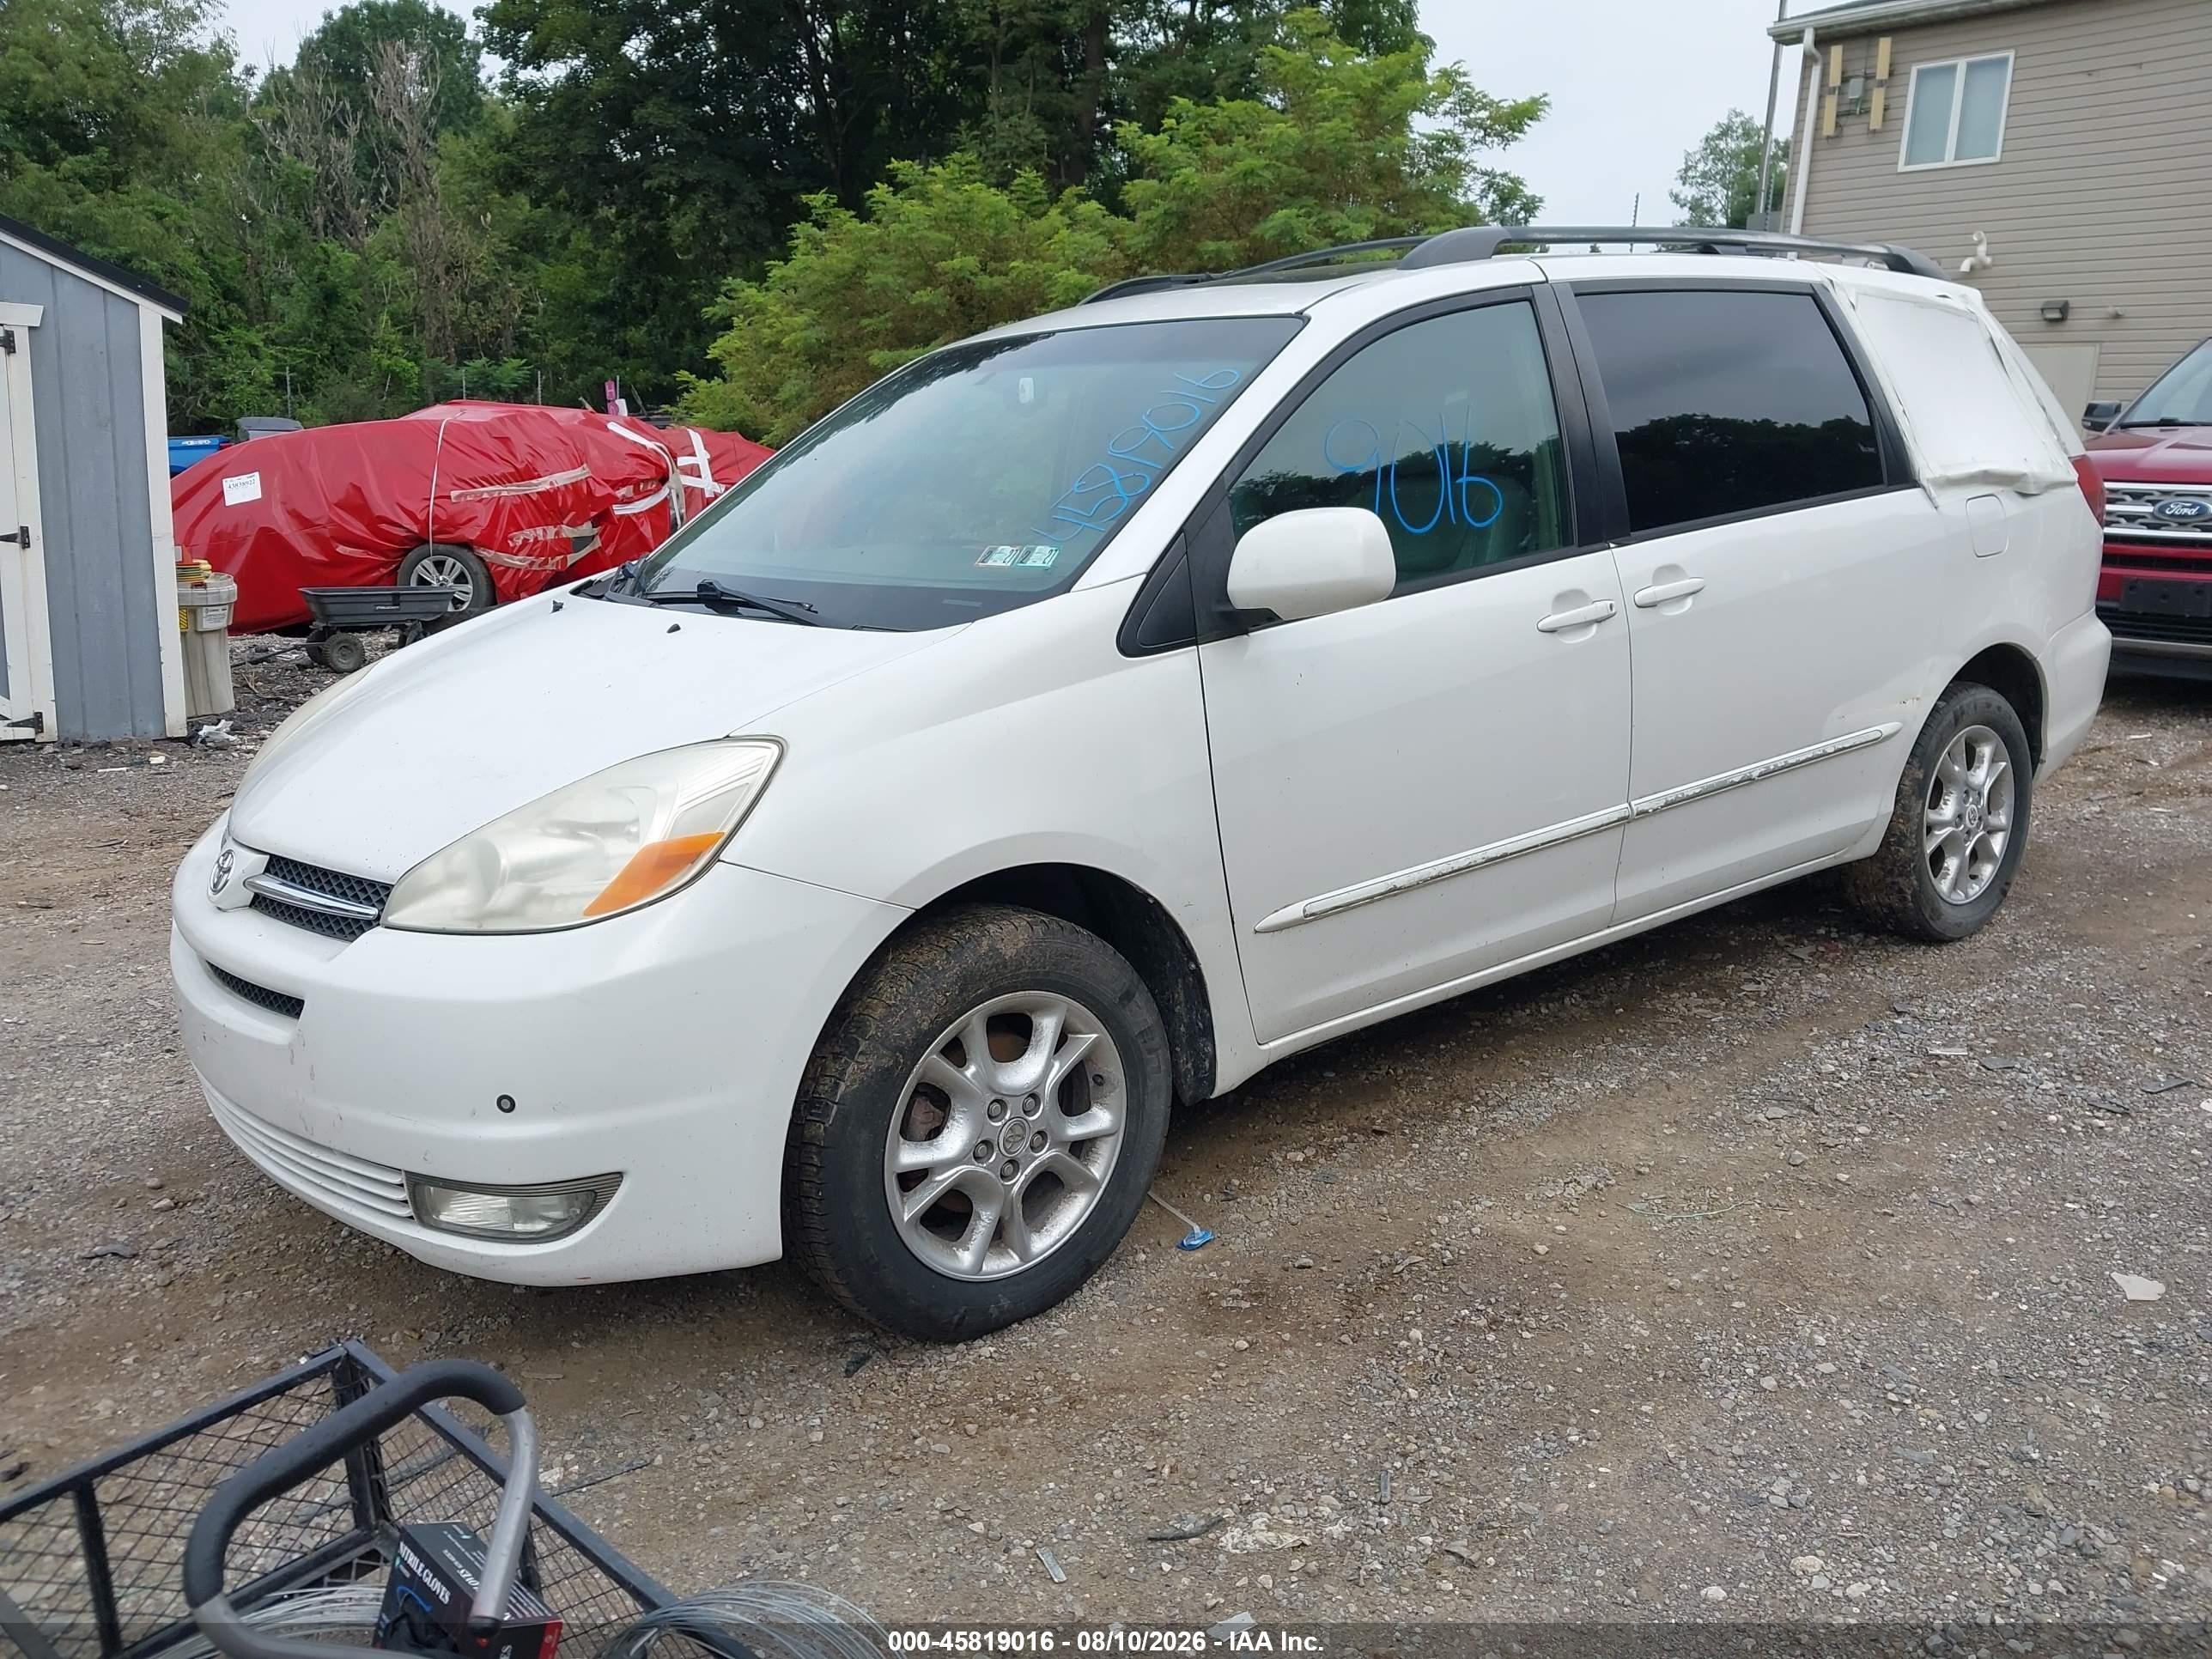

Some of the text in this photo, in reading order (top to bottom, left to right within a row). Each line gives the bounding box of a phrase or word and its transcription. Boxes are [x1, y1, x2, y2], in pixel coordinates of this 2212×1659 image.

[1030, 369, 1240, 542] 45819016
[1324, 404, 1502, 533] 9016
[2166, 501, 2200, 516] Ford
[398, 1541, 424, 1577] NITRILE
[422, 1566, 451, 1605] GLOVES
